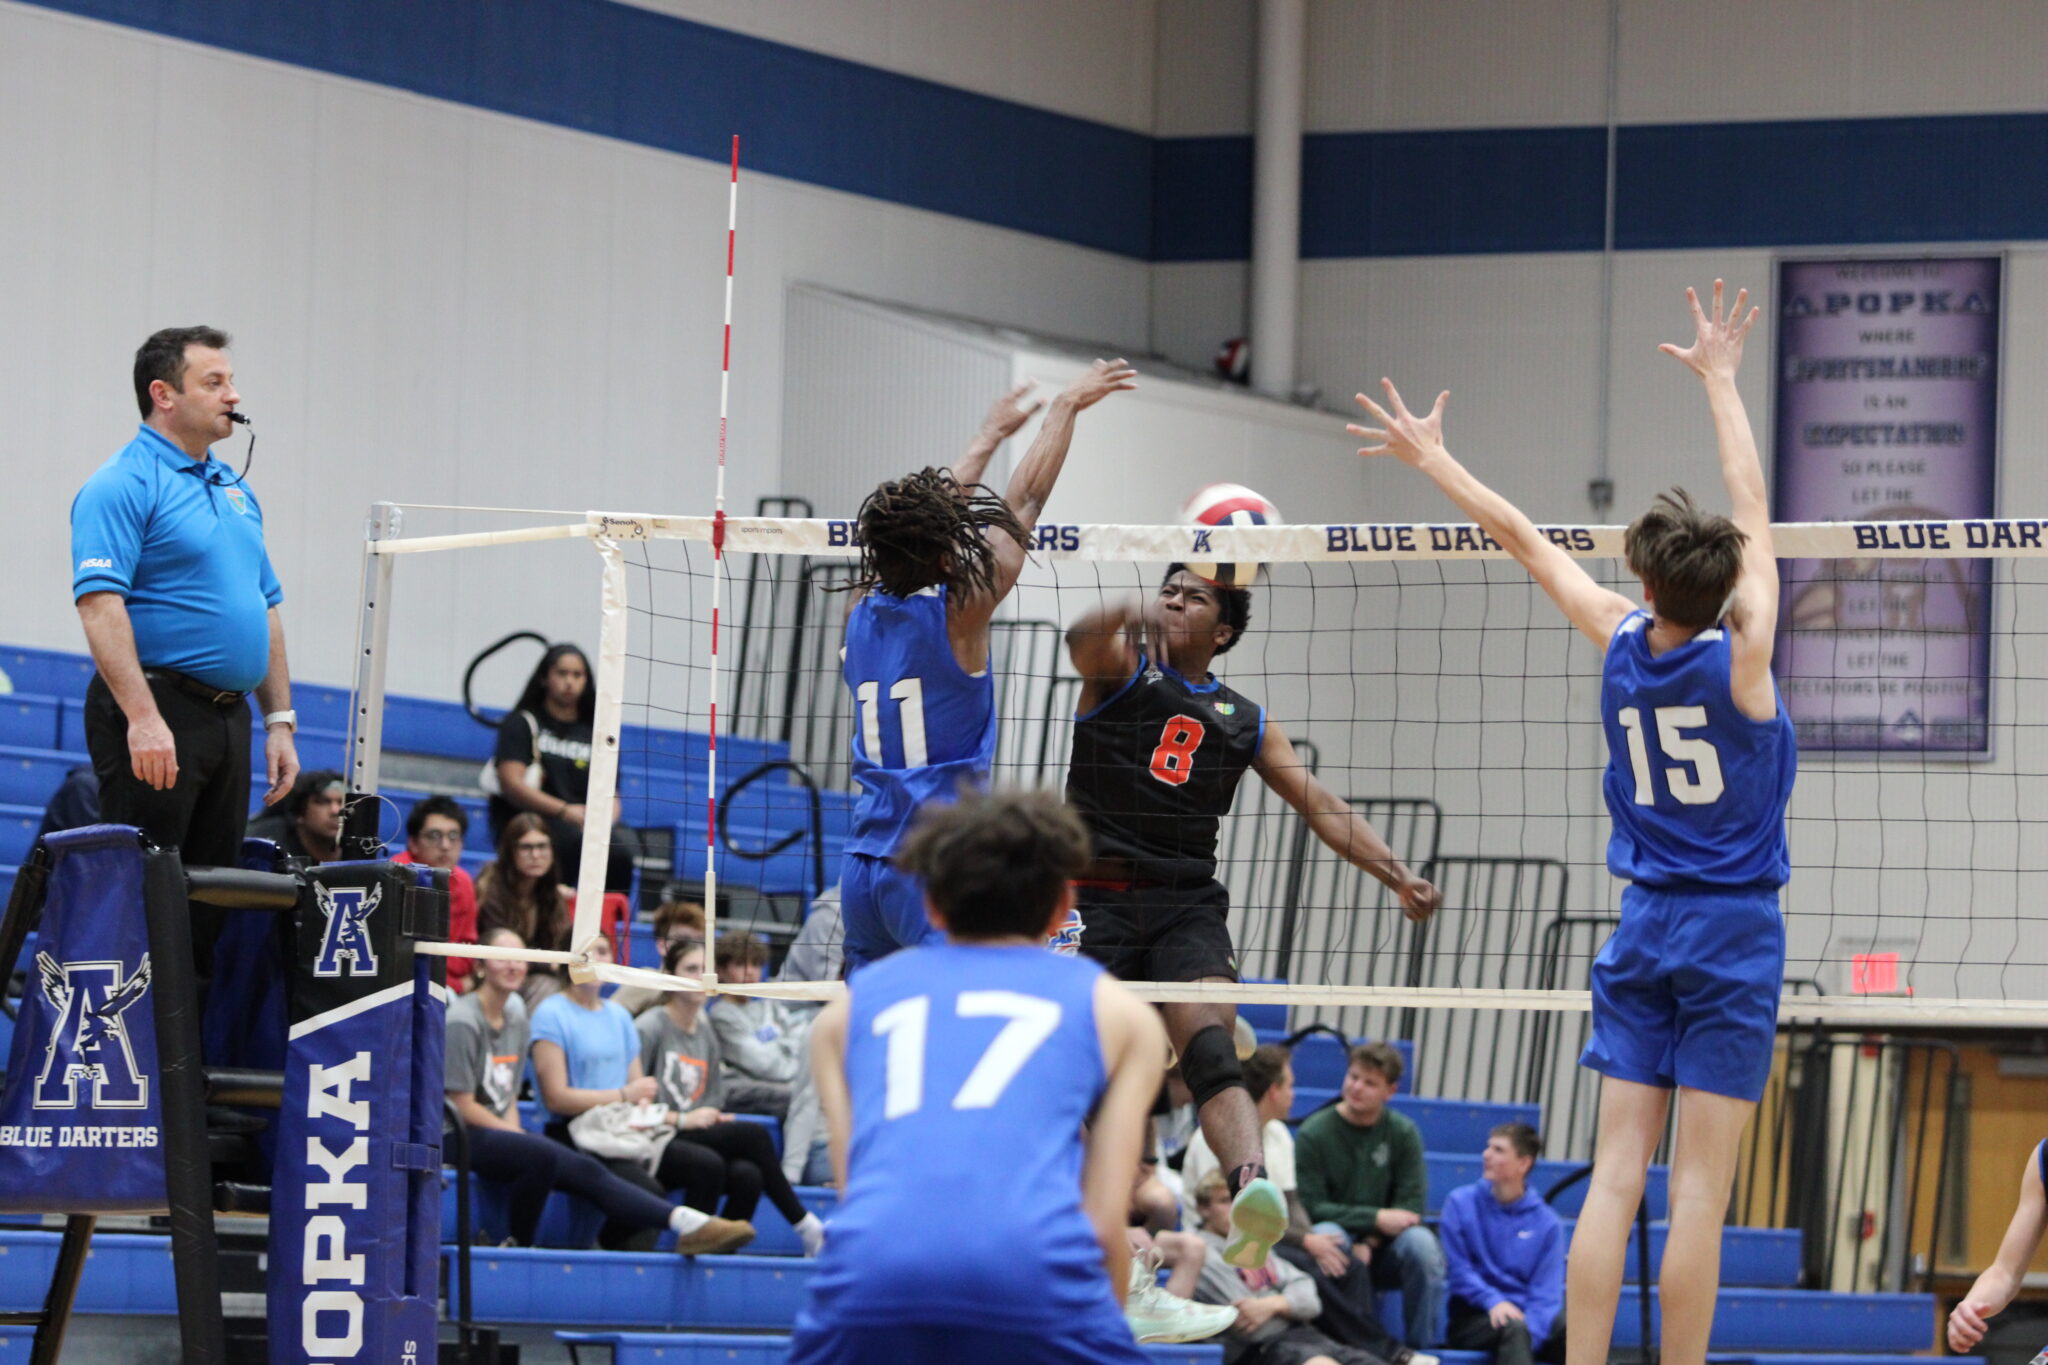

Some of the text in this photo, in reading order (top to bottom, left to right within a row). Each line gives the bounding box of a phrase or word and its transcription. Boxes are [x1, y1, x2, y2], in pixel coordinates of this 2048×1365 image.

[1787, 291, 1989, 316] APOPKA
[1859, 329, 1915, 343] WHERE
[1866, 459, 1926, 475] PLEASE
[1852, 487, 1913, 504] LET THE
[1327, 526, 1416, 552] BLUE
[1853, 523, 1951, 549] BLUE
[857, 677, 928, 770] 11
[1149, 714, 1206, 787] 8
[1618, 705, 1725, 806] 15
[871, 990, 1063, 1120] 17
[0, 1126, 158, 1147] BLUE DARTERS
[302, 1051, 371, 1365] OPKA
